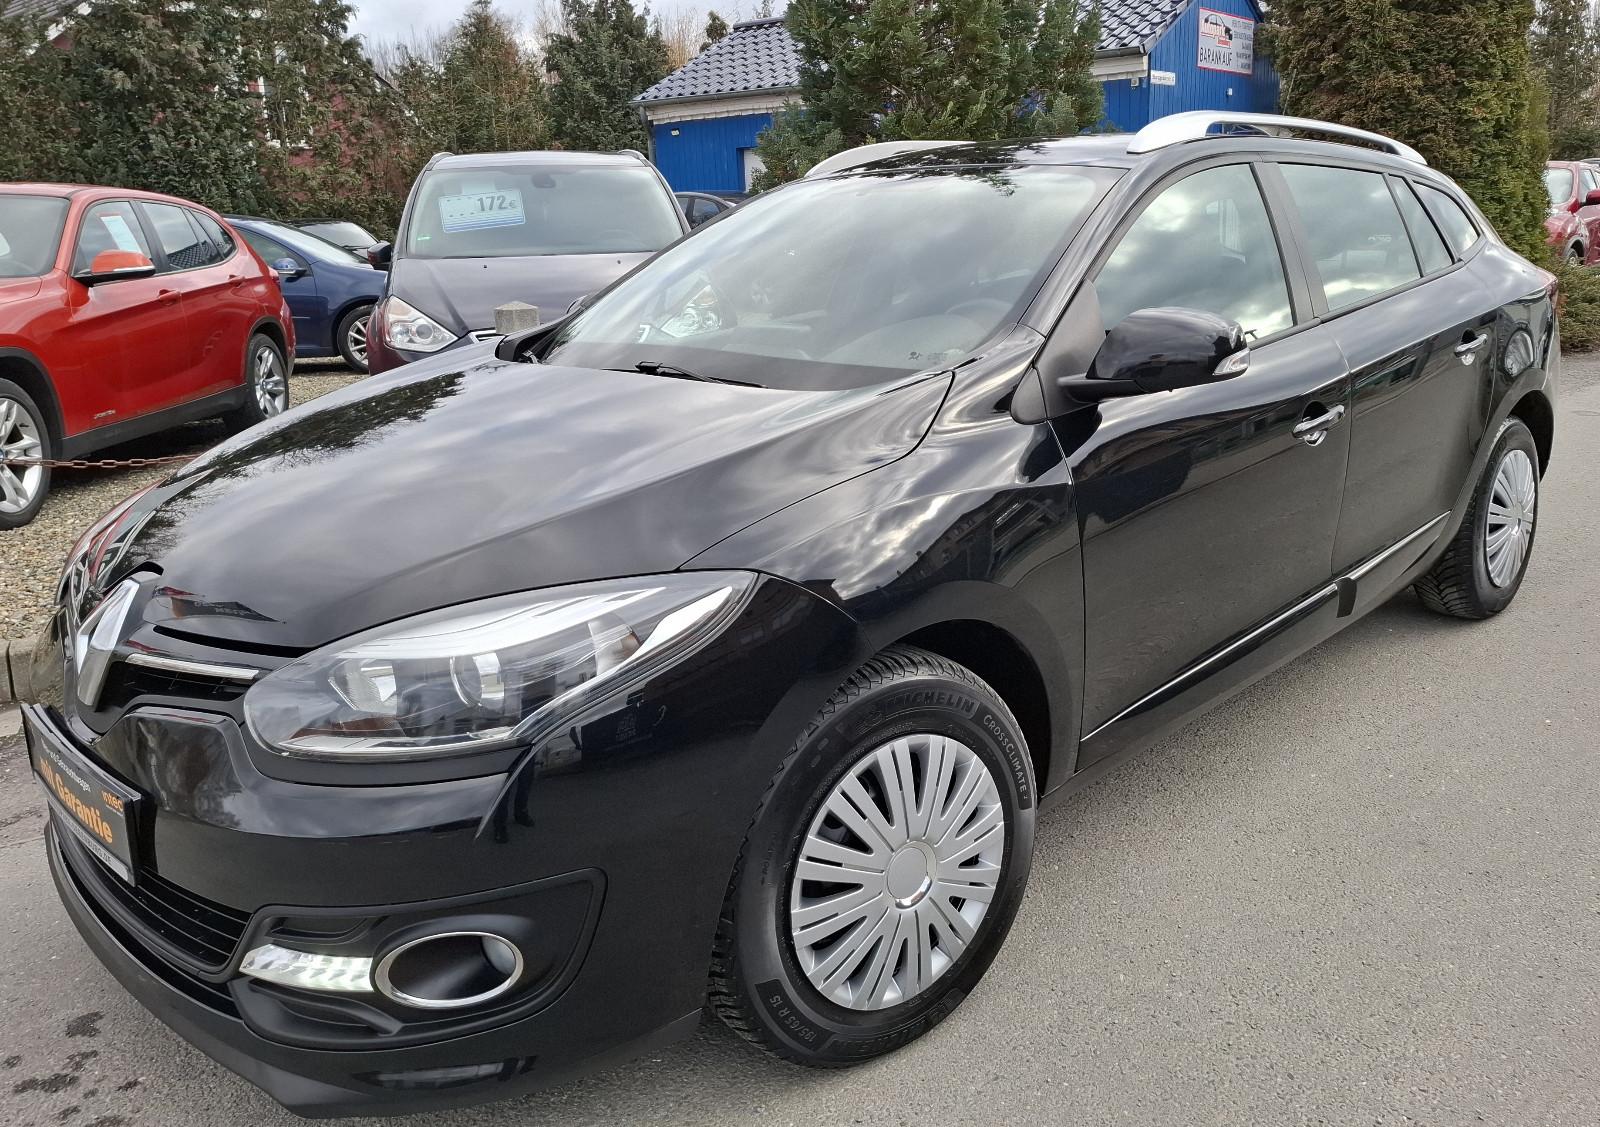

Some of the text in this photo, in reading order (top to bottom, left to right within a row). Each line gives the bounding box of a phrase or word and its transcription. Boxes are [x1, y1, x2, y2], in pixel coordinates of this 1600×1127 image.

[1200, 47, 1232, 66] BARANKAUF
[887, 688, 976, 714] MICHELIN
[983, 713, 1027, 794] CROSSCLIMATE
[55, 772, 113, 844] Garantie
[769, 995, 817, 1042] 195/65 R 15
